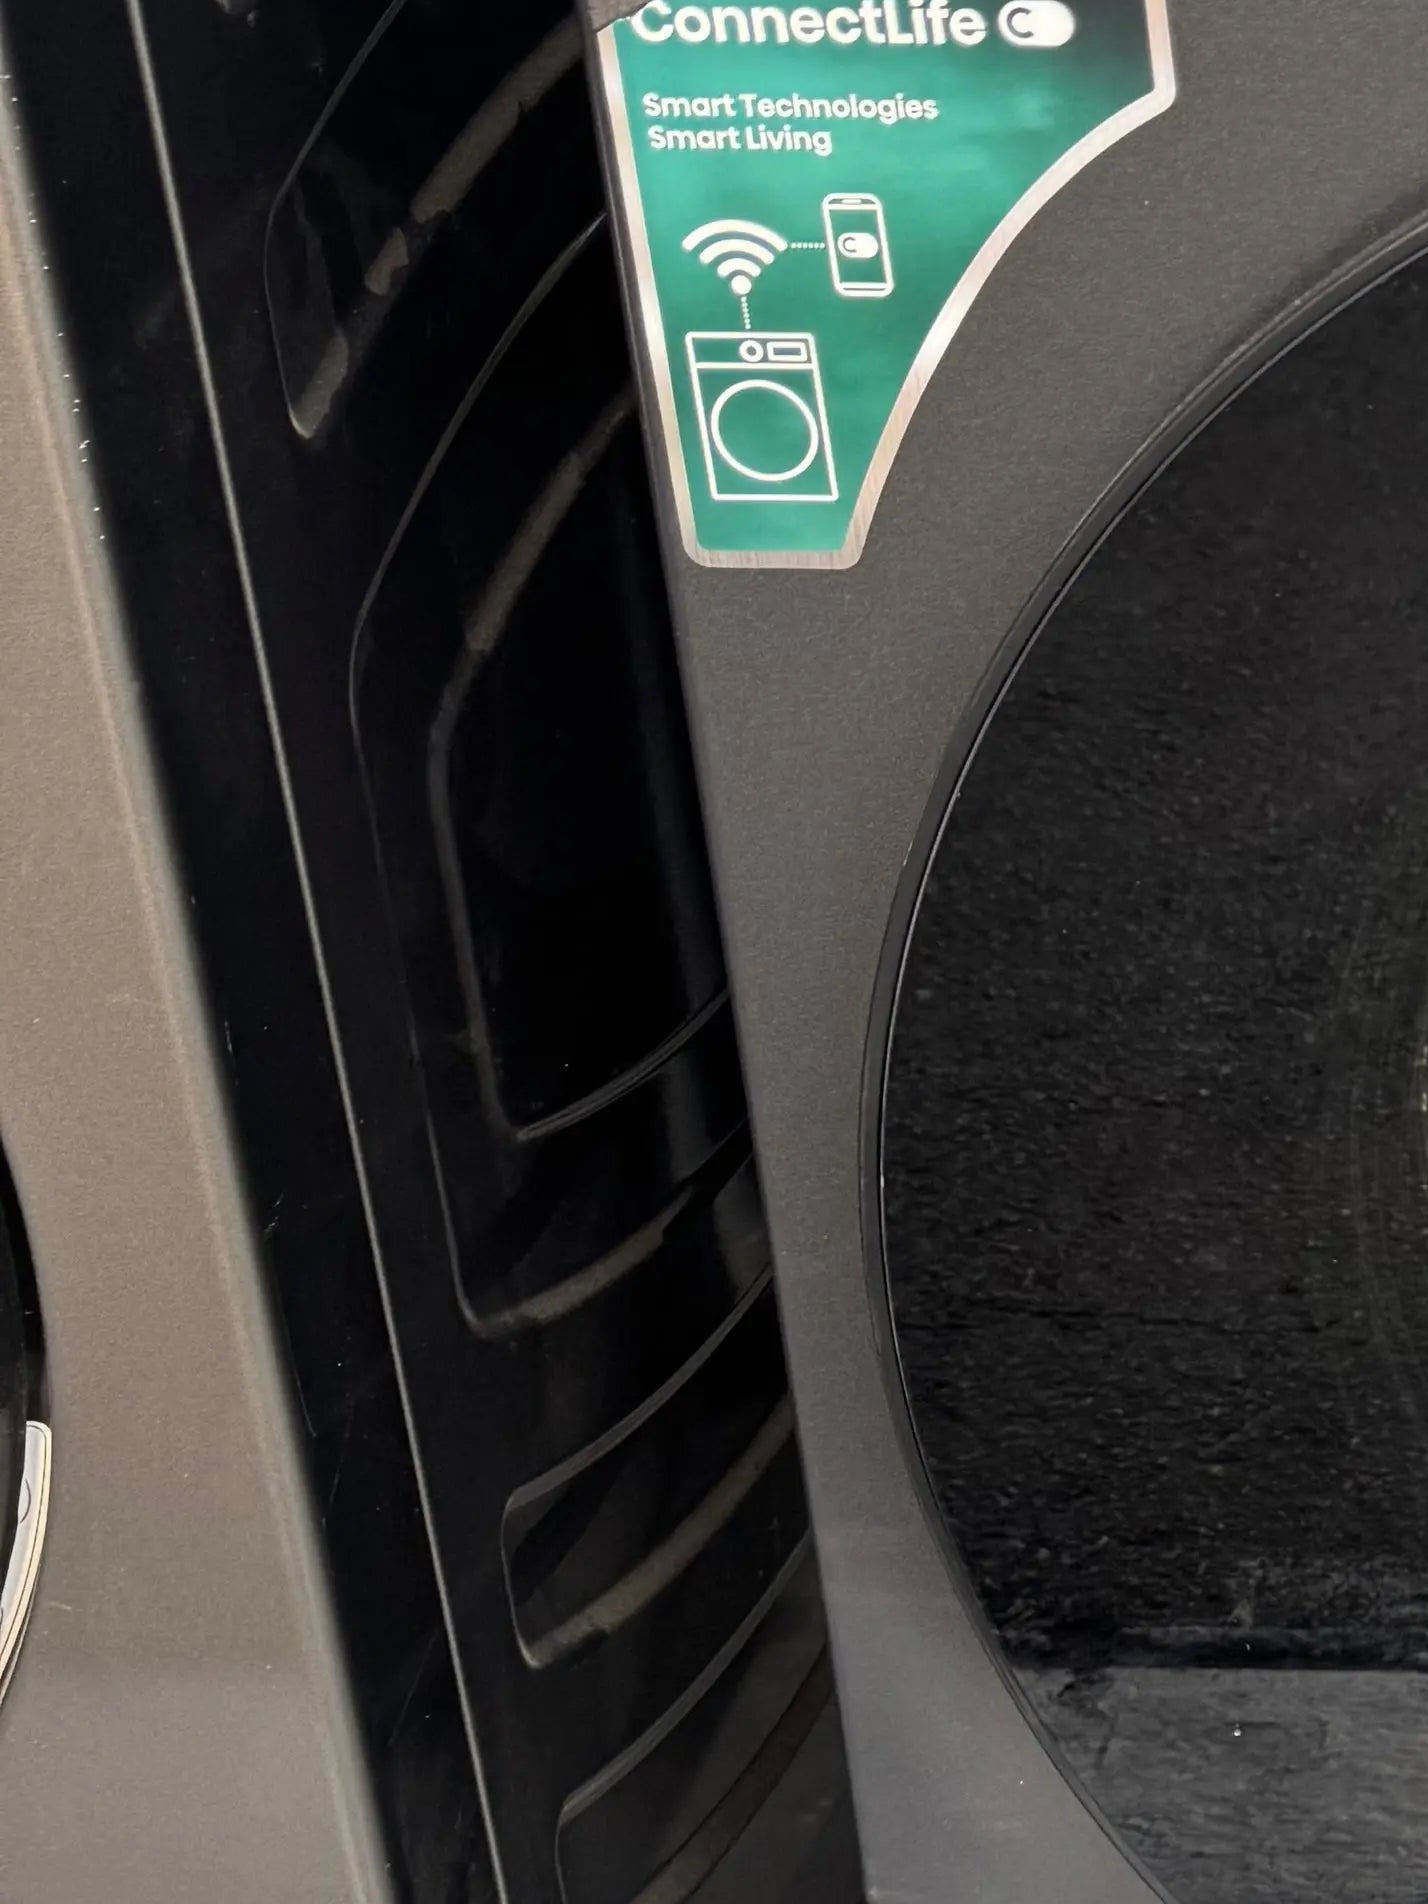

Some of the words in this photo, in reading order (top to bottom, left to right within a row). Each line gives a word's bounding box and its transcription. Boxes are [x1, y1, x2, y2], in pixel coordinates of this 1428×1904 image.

[643, 91, 737, 118] Smart
[738, 92, 940, 125] Technologies
[647, 124, 741, 150] Smart
[745, 124, 833, 157] Living
